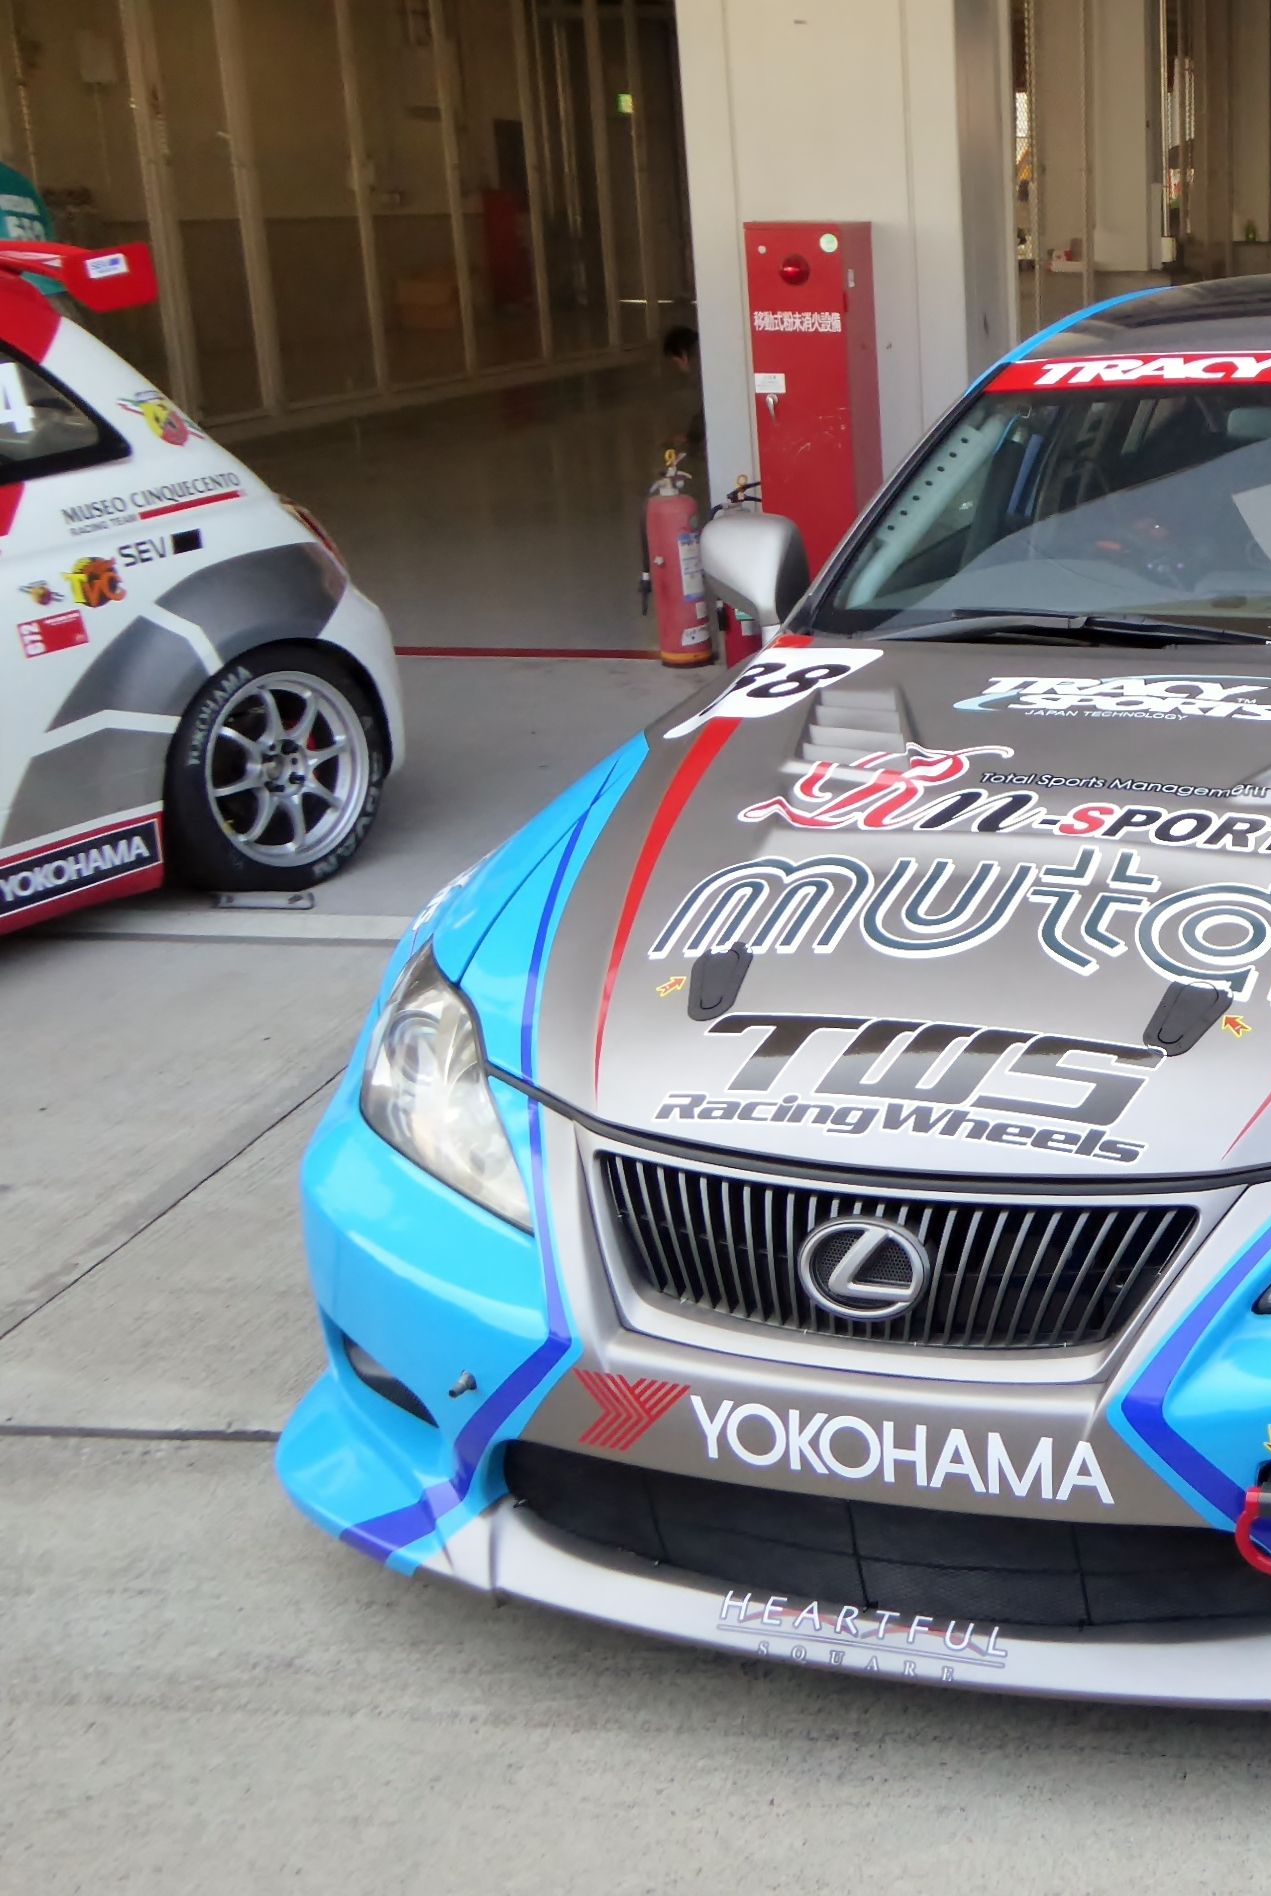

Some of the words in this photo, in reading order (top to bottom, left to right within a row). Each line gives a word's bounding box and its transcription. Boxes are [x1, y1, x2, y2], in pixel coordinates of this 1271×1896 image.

[753, 311, 842, 333] 移動式粉末消火設備
[62, 496, 128, 524] MUSEO
[129, 472, 241, 508] CINQUECENTO
[118, 536, 166, 568] SEV
[982, 677, 1270, 702] TRACY
[1025, 709, 1078, 718] JAPAN
[1084, 711, 1188, 721] TECHNOLOGY
[979, 771, 1034, 785] Total
[1035, 774, 1105, 790] Sports
[0, 835, 150, 902] YOKOHAMA
[705, 1014, 1165, 1127] TWS
[691, 1395, 1115, 1505] YOKOHAMA
[720, 1590, 1008, 1658] HEARTFUL
[757, 1640, 956, 1682] SQUARE
